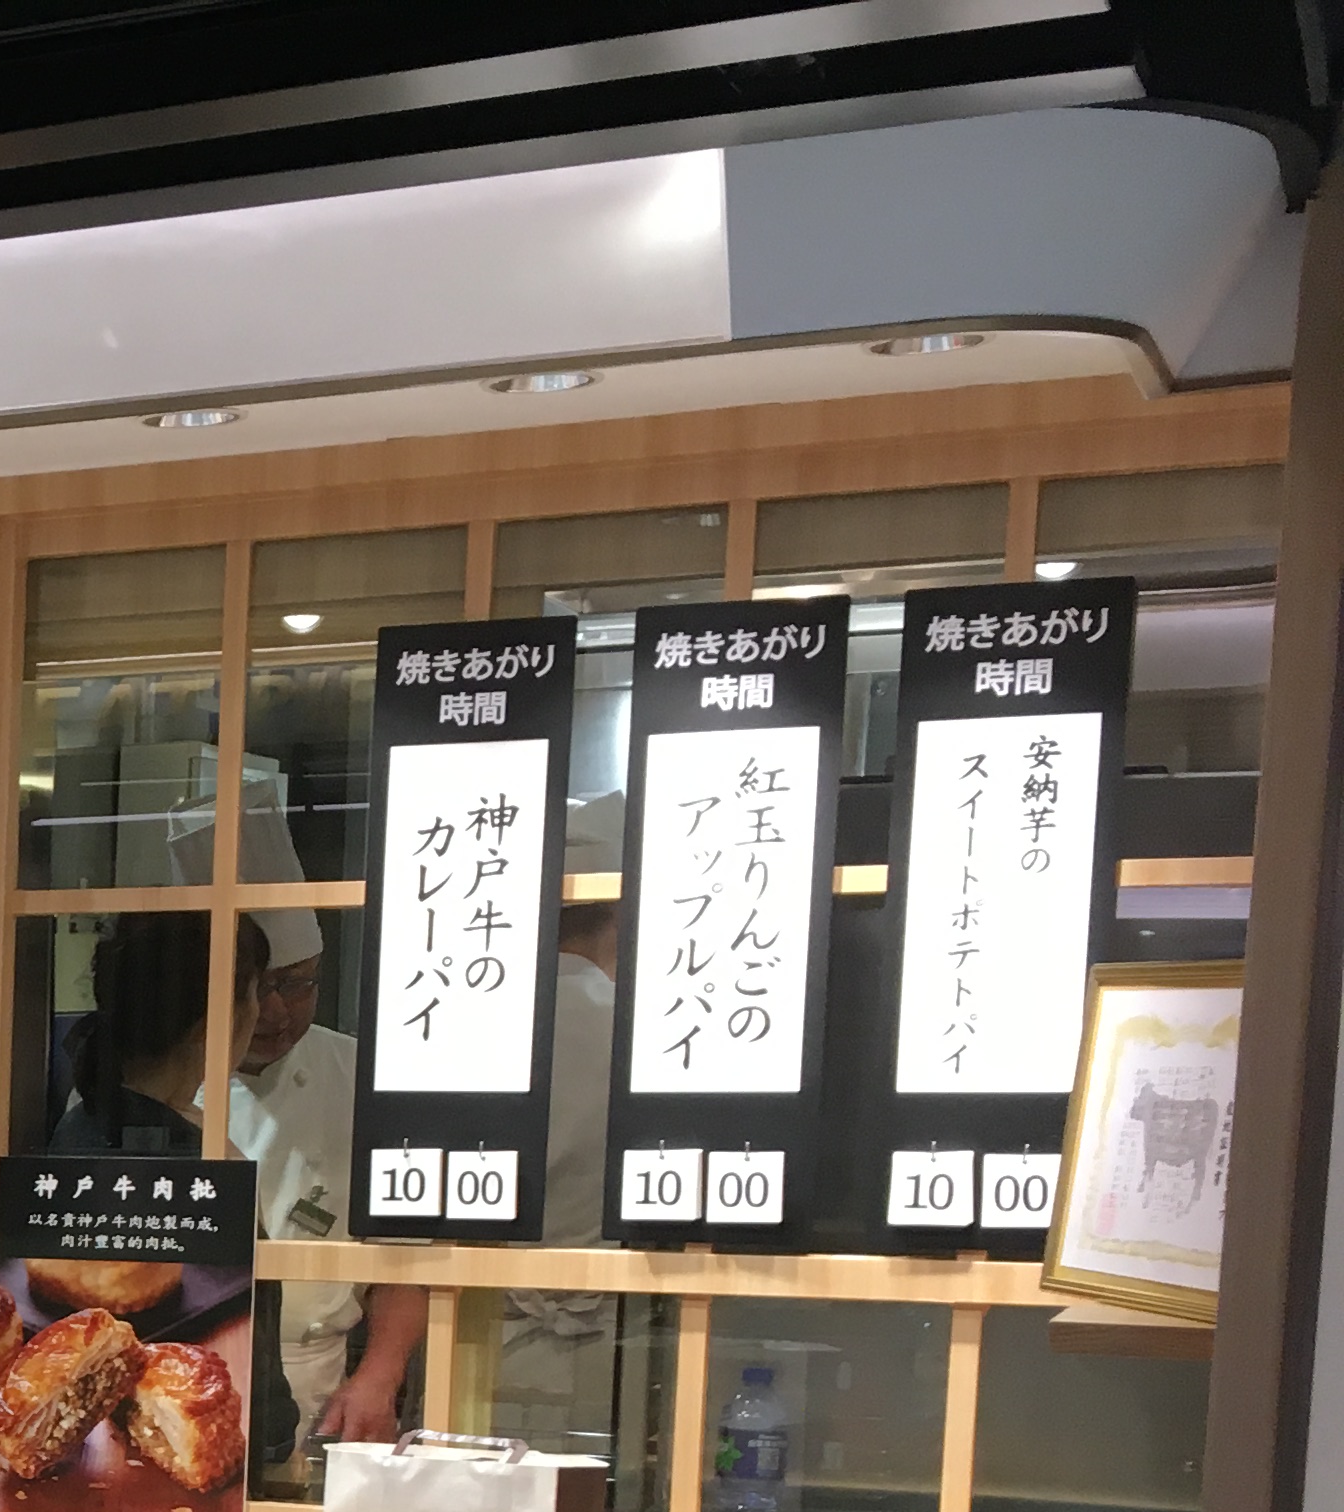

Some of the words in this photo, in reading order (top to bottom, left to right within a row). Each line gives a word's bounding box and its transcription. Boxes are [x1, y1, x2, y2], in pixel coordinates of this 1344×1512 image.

[653, 624, 827, 669] 焼きあがり
[925, 605, 1110, 655] 焼きあがり
[396, 643, 556, 686] 焼きあがり
[974, 657, 1052, 698] 時間
[438, 691, 507, 728] 時間
[700, 673, 773, 710] 時間
[1020, 735, 1062, 874] 安納芋の
[727, 756, 791, 1044] 紅玉りんごの
[942, 752, 989, 1075] スイートポテトパイ
[403, 816, 455, 1041] カレーパイ
[663, 795, 723, 1070] アップルパイ
[381, 1167, 426, 1204] 10
[457, 1169, 503, 1205] 00
[635, 1169, 682, 1206] 10
[718, 1171, 769, 1208] 00
[904, 1172, 955, 1212] 10
[994, 1173, 1048, 1213] 00
